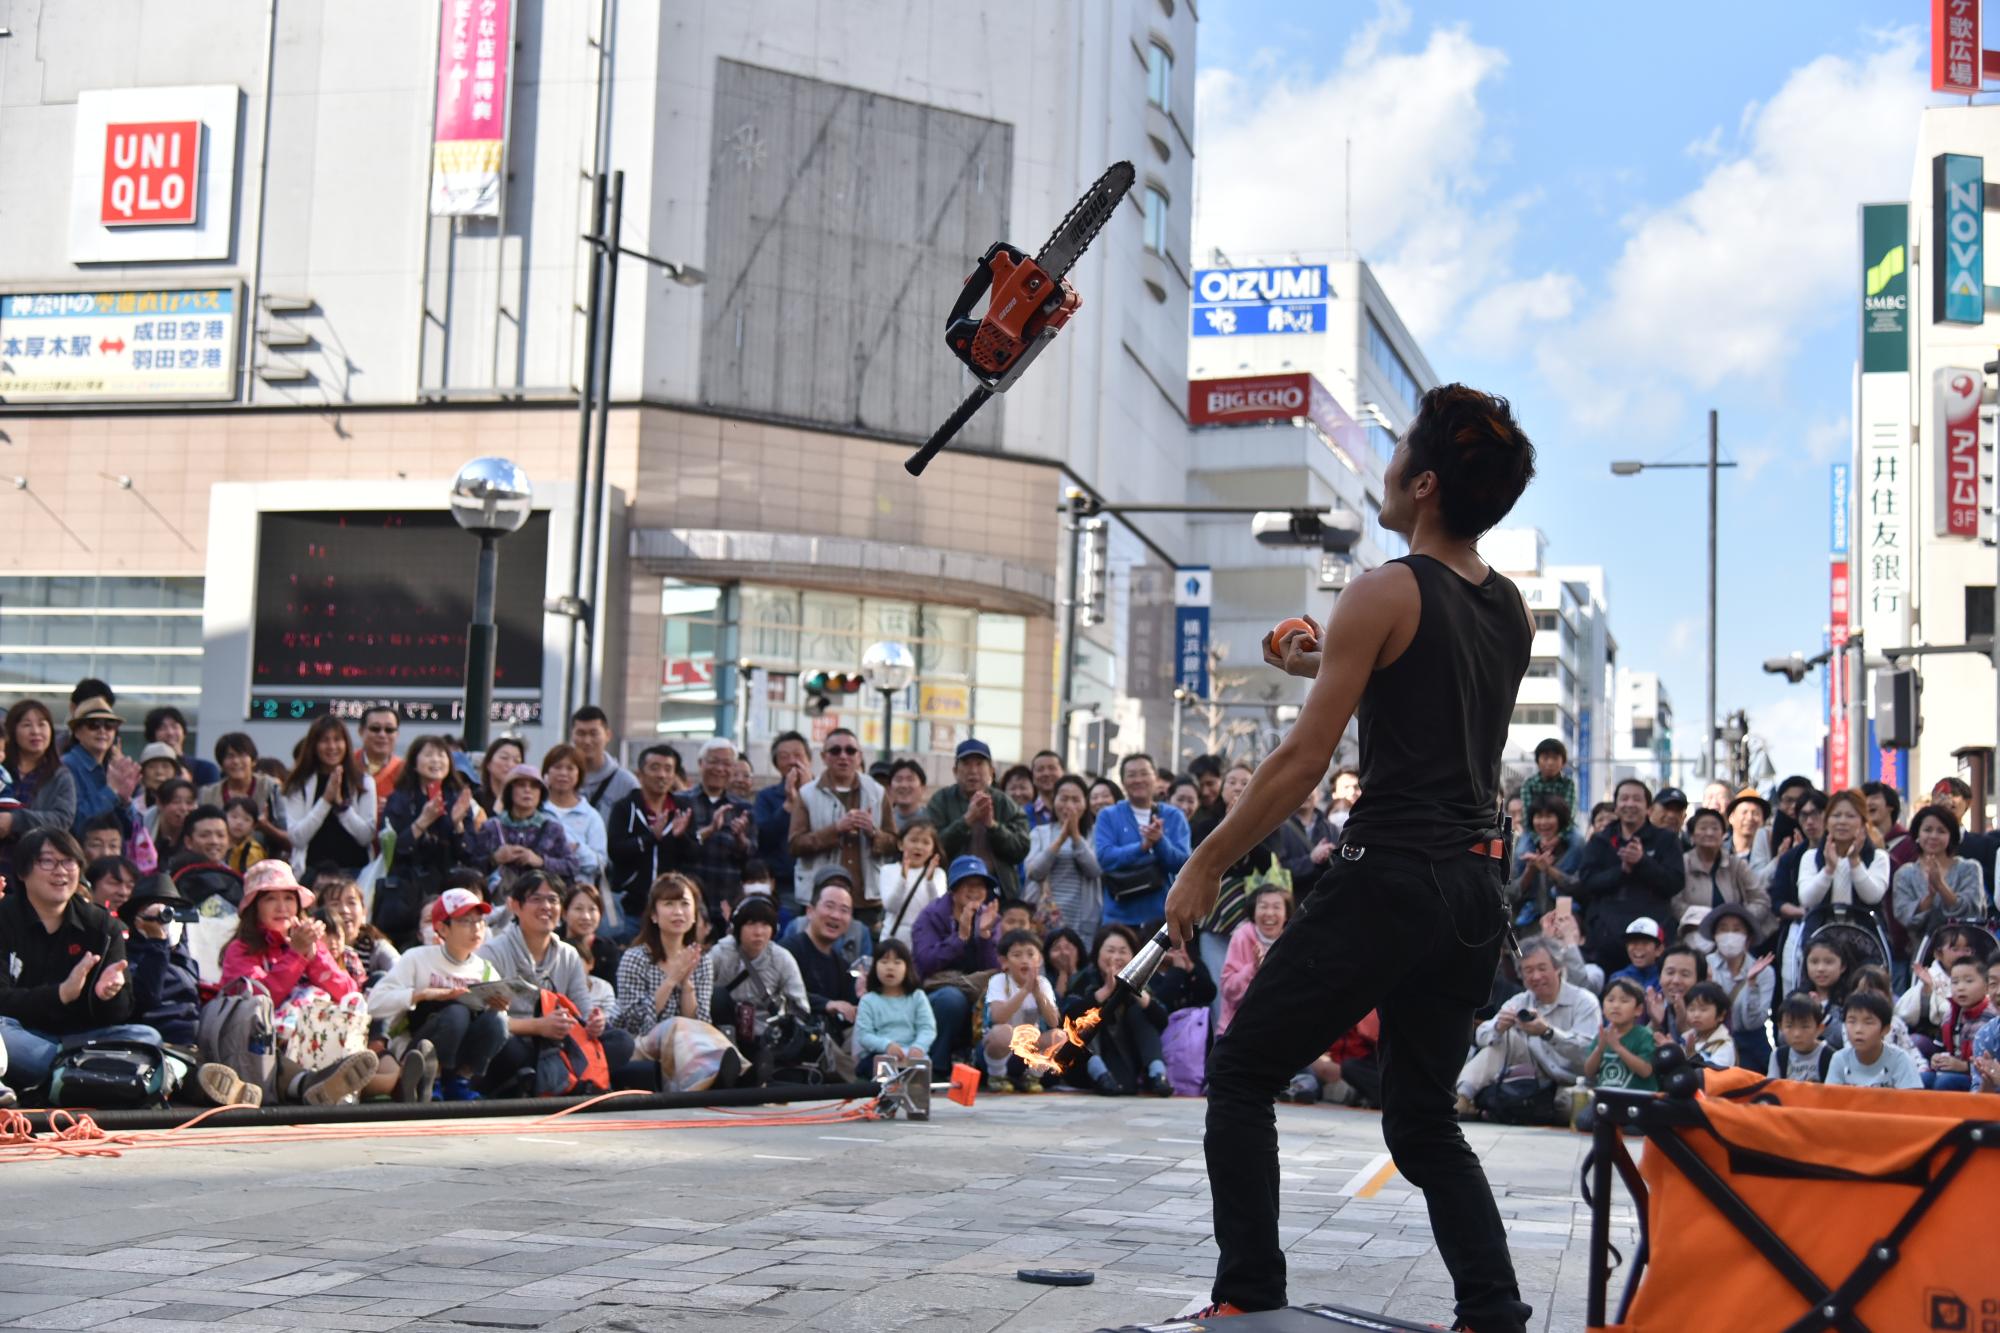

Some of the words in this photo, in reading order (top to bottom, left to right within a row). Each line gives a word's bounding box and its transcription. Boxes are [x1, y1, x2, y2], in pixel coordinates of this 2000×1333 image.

[114, 132, 181, 170] UNI
[111, 173, 185, 217] QLO
[1951, 182, 1979, 297] NOVA
[1200, 268, 1321, 302] OIZUMI
[1865, 294, 1906, 310] SMBC
[133, 320, 224, 341] 成田空港
[3, 336, 92, 358] 本厚木駅
[132, 348, 222, 370] 羽田空港
[1207, 390, 1245, 414] BIG
[1247, 387, 1304, 408] ECHO
[1952, 429, 1976, 505] アコム
[1871, 422, 1900, 613] 三井住友銀行
[1953, 510, 1976, 527] 3F
